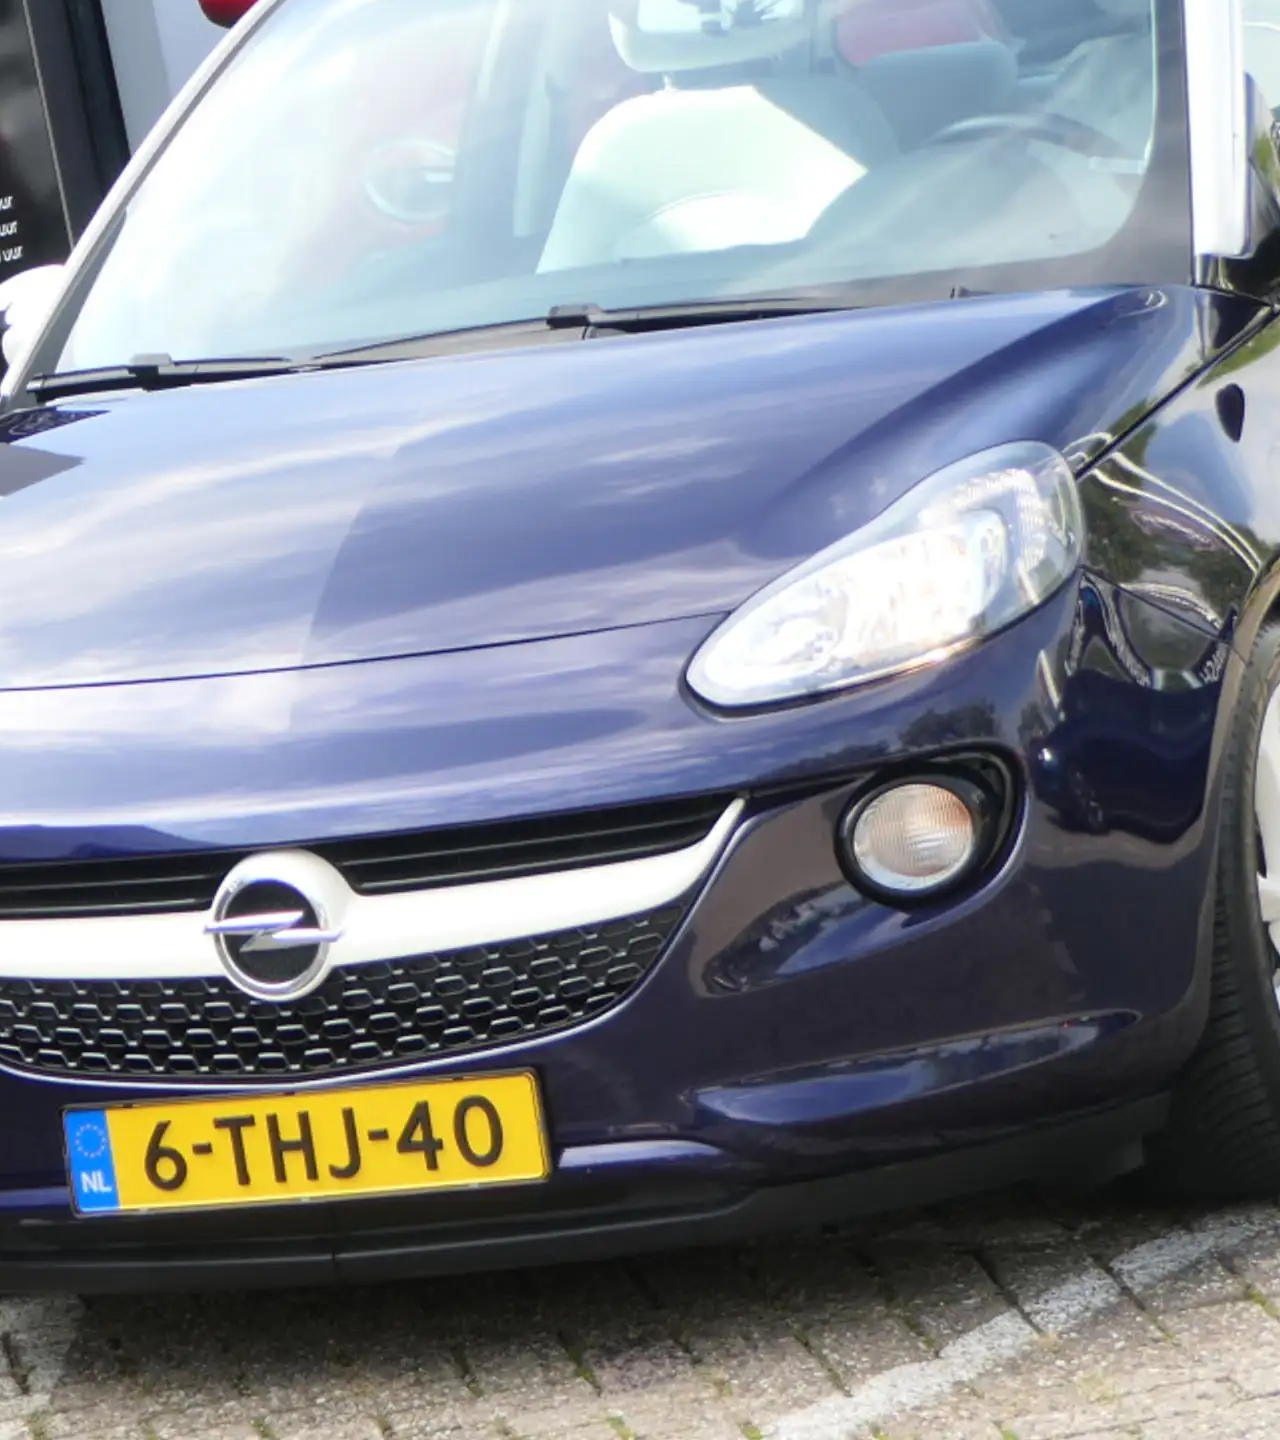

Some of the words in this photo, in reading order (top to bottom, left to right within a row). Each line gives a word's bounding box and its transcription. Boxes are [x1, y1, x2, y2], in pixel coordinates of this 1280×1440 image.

[2, 245, 23, 262] uur
[143, 1093, 505, 1194] 6-THJ-40
[81, 1170, 113, 1193] NL
